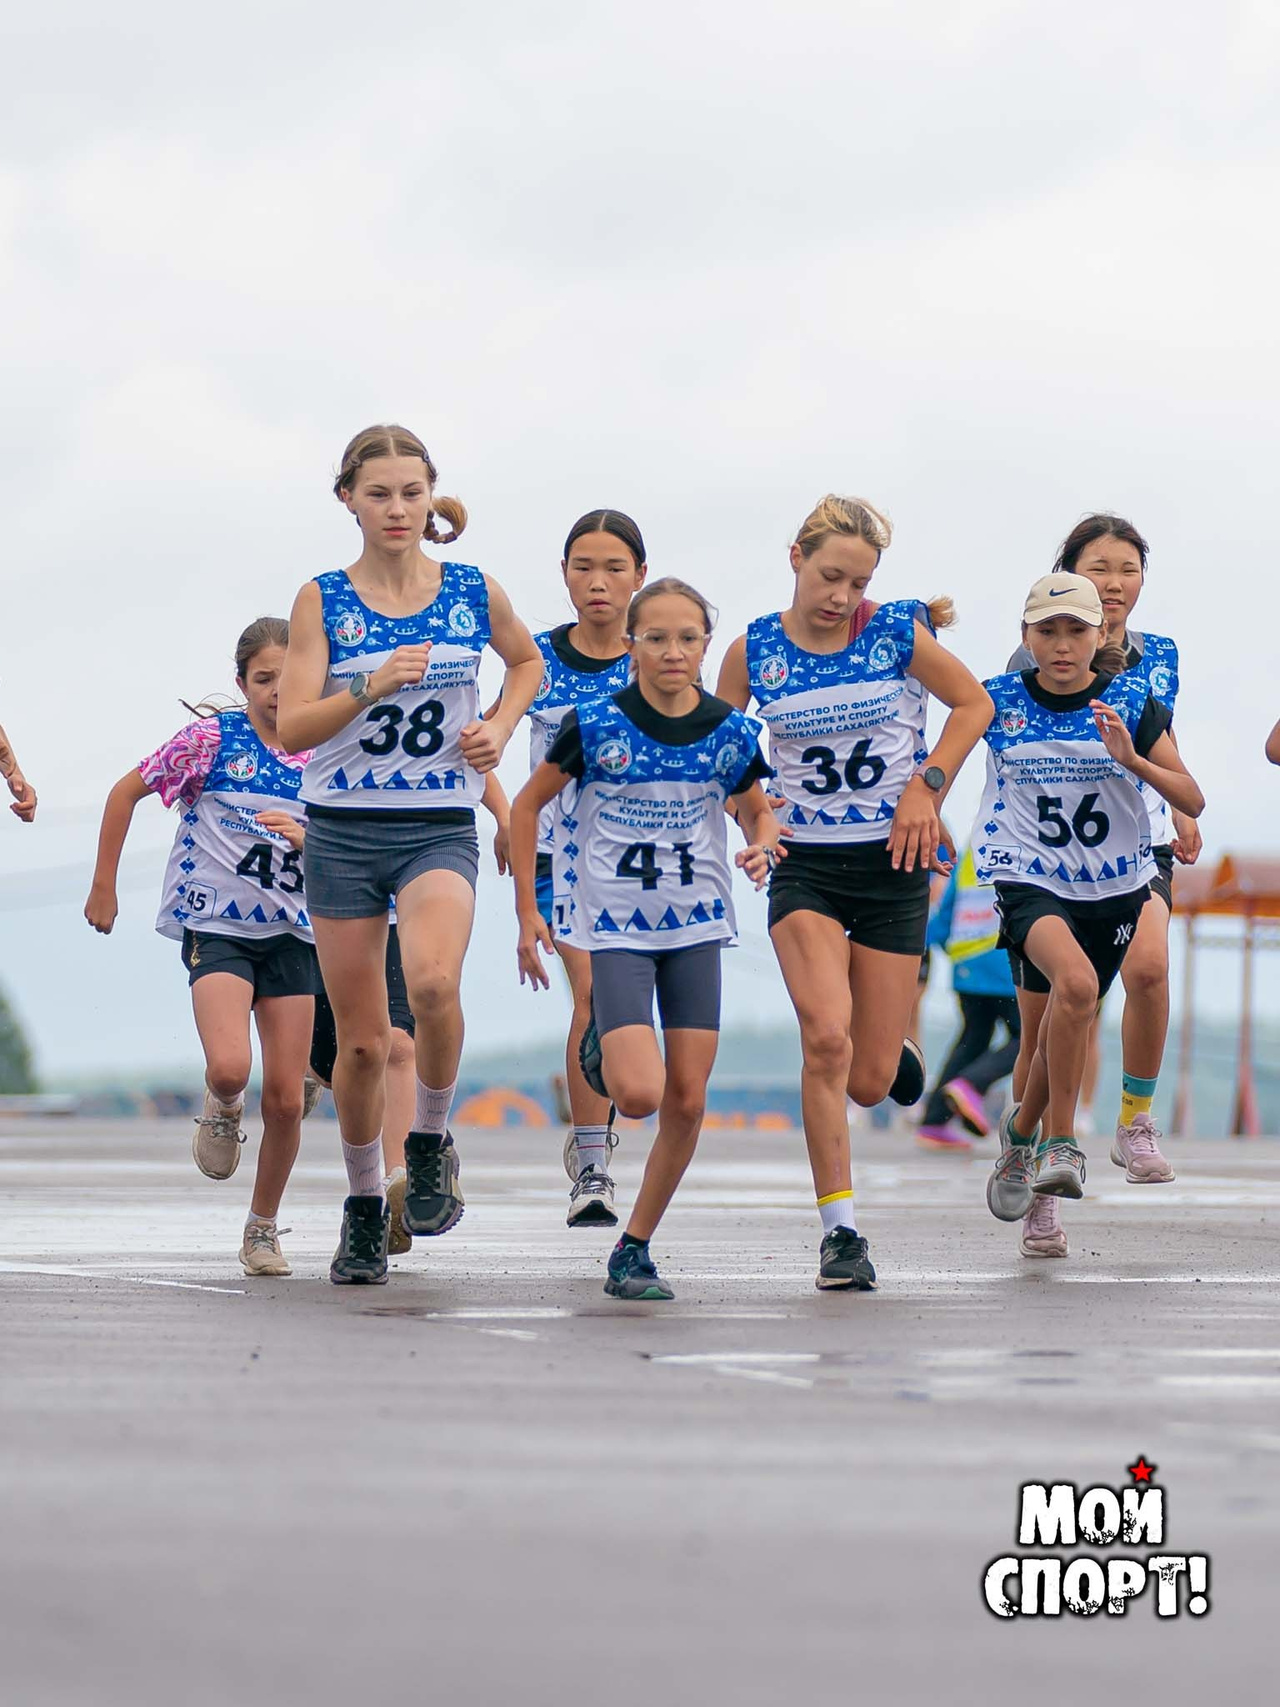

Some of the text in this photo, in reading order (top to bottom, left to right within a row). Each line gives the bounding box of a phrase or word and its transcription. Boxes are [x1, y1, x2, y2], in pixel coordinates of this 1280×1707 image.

[427, 671, 464, 681] СПОРТУ
[833, 703, 848, 713] ПО
[785, 706, 887, 731] КУЛЬТУРЕ И СПОРТУ
[359, 699, 445, 758] 38
[800, 738, 888, 795] 36
[1065, 757, 1077, 765] ПО
[1020, 766, 1065, 775] КУЛЬТУРЕ
[1077, 766, 1114, 775] СПОРТУ
[1014, 775, 1062, 786] СПУБЛИКИ
[599, 811, 663, 828] РЕСПУБЛИКИ
[620, 807, 667, 818] КУЛЬТУРЕ
[1037, 793, 1110, 848] 56
[616, 841, 695, 890] 41
[989, 850, 1013, 867] 56
[236, 843, 304, 894] 45
[186, 889, 206, 911] 45
